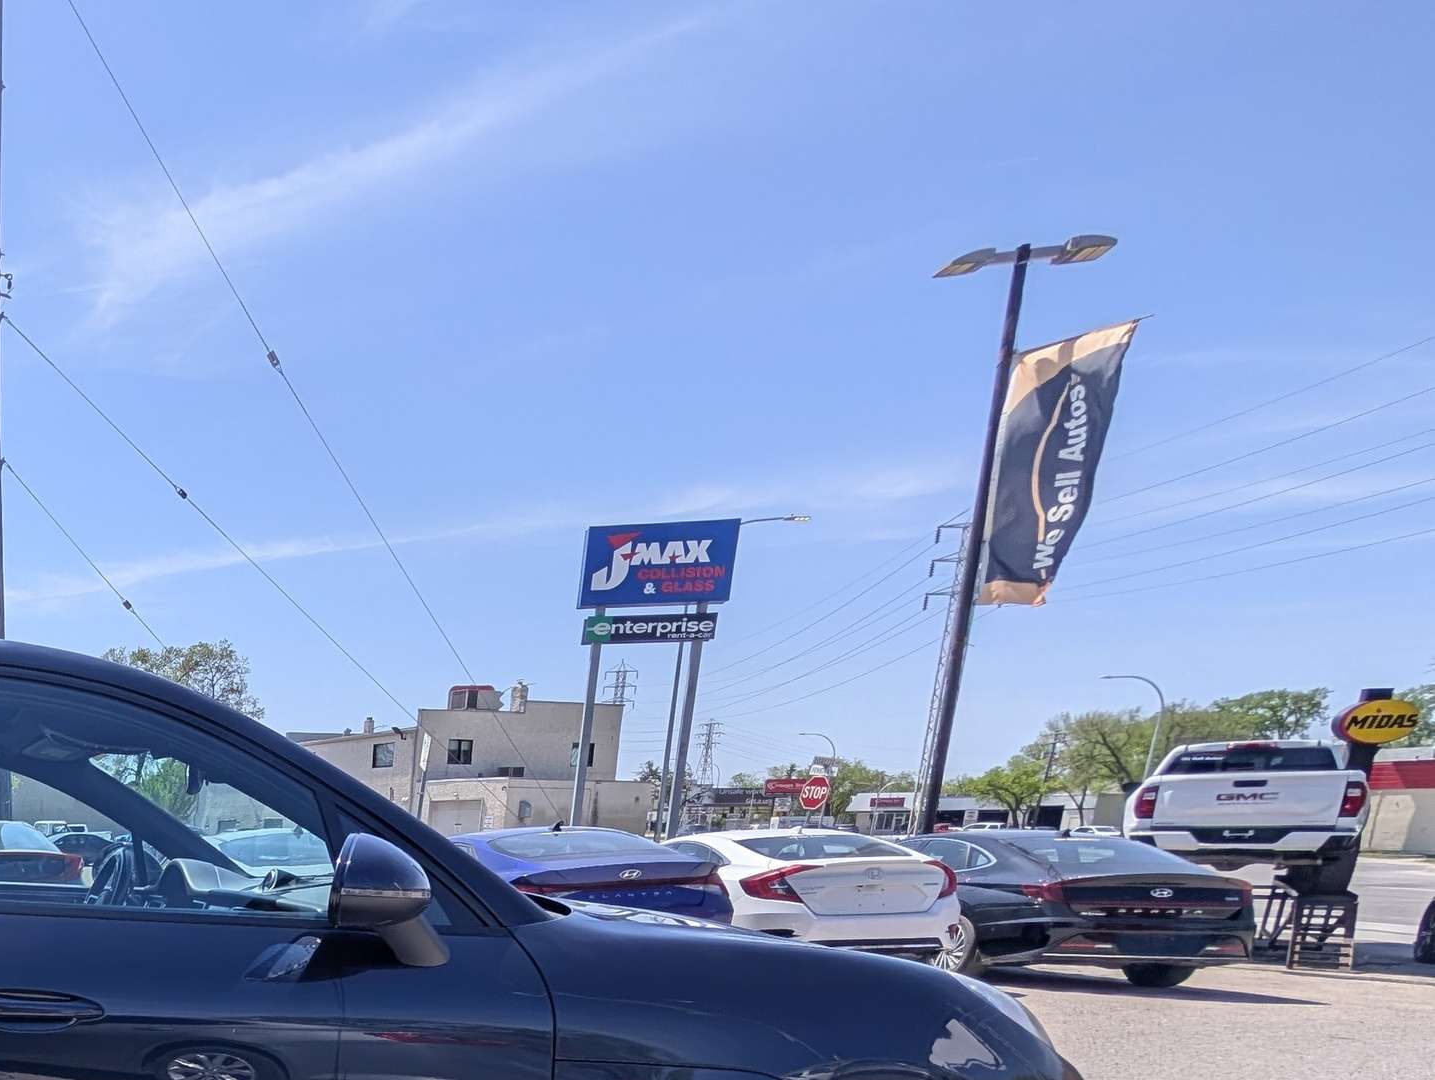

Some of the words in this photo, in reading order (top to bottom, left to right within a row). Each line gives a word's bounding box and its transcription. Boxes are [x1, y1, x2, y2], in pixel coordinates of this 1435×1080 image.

[1058, 384, 1090, 463] Autos
[1047, 470, 1083, 524] Sell
[1032, 527, 1065, 570] We
[636, 565, 727, 581] COLLISION
[643, 582, 656, 595] &
[661, 579, 716, 593] GLASS
[593, 617, 715, 637] enterprise
[1346, 712, 1419, 730] MIDAS
[802, 785, 827, 800] STOP
[1215, 792, 1280, 802] GMC
